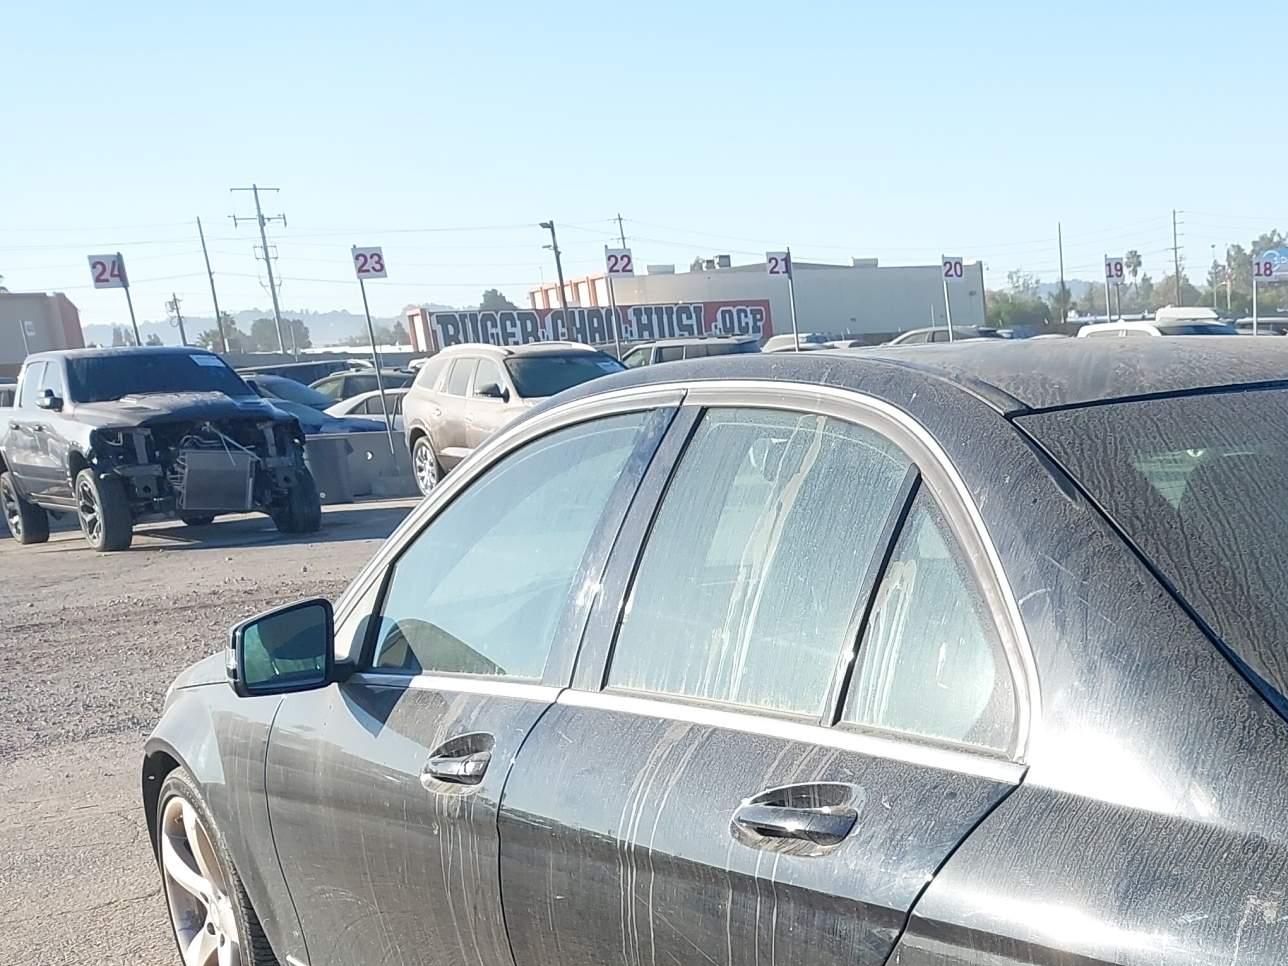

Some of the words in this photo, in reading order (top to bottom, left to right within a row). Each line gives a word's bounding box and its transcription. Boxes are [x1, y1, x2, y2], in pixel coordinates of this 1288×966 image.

[91, 260, 125, 283] 24
[354, 253, 385, 273] 23
[607, 254, 633, 273] 22
[768, 256, 791, 275] 21
[943, 260, 964, 278] 20
[1105, 261, 1124, 278] 19
[1253, 261, 1274, 278] 18
